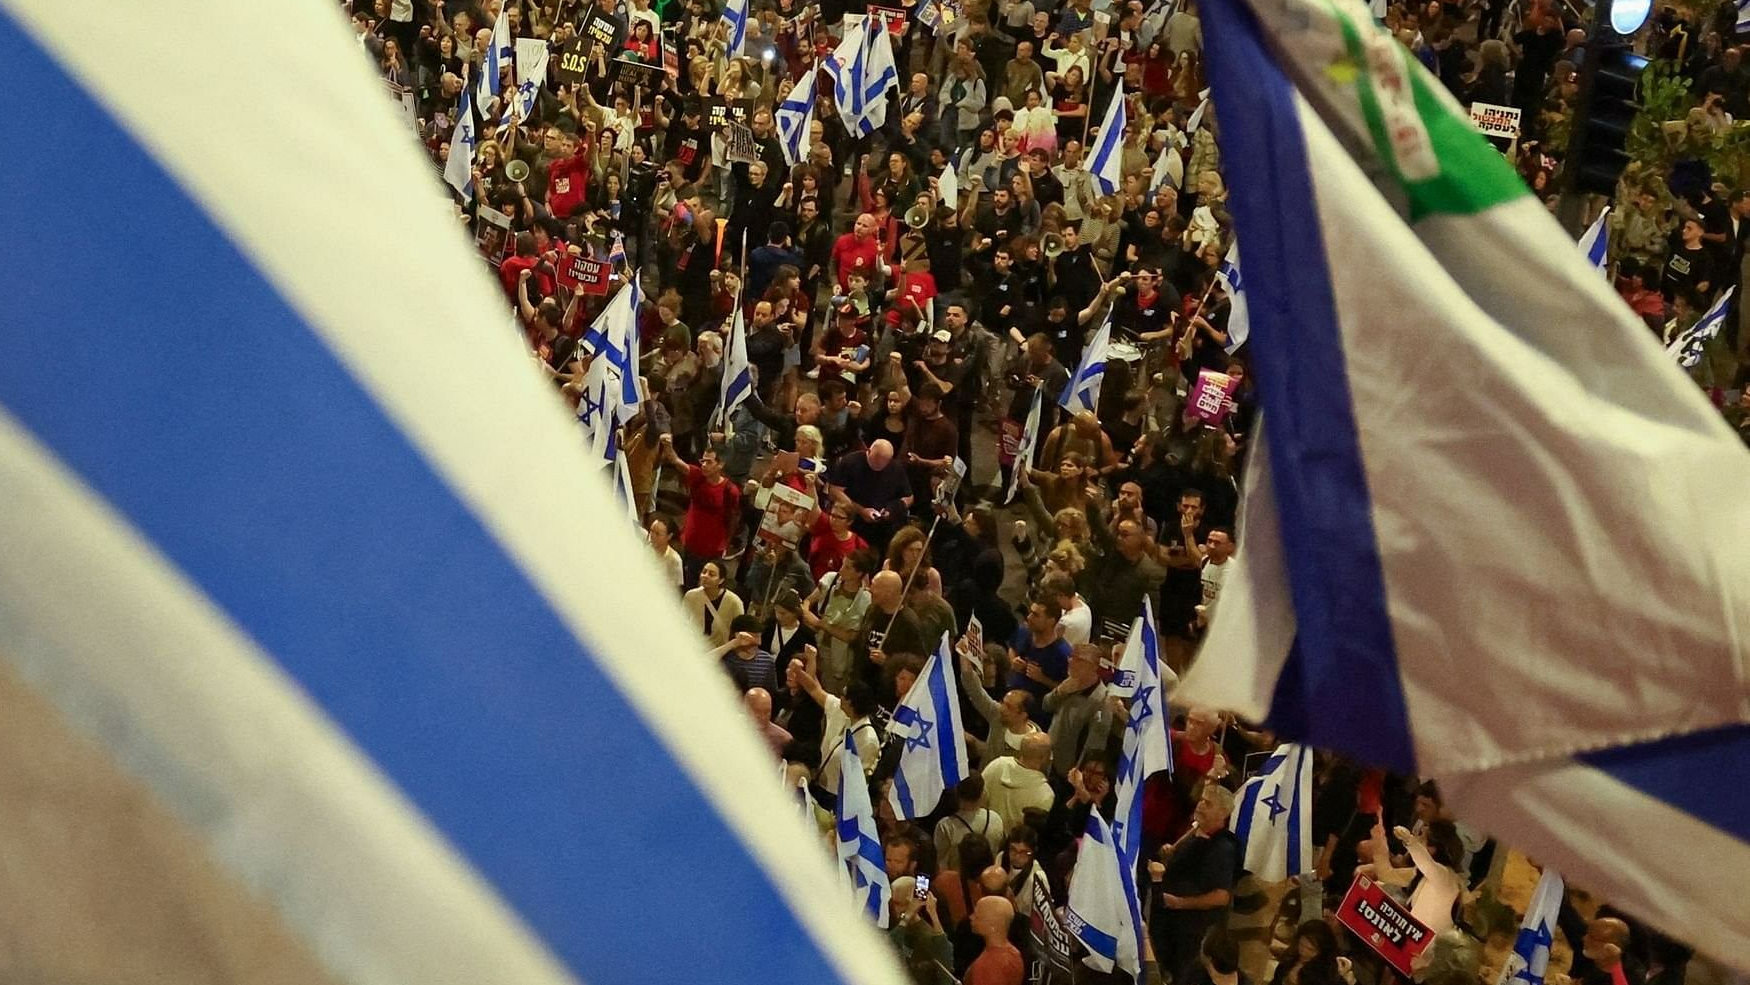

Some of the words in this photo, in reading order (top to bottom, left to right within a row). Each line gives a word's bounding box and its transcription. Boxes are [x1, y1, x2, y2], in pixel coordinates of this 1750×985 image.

[588, 26, 613, 45] עכשיו!
[561, 52, 587, 73] S.O.S
[1473, 112, 1510, 125] המכשול
[1484, 108, 1519, 120] נתניהו
[1479, 122, 1516, 133] לעסקה
[575, 259, 600, 273] עסקה
[569, 269, 598, 283] עכשיו!
[1358, 900, 1402, 943] לאונס!
[1405, 924, 1424, 942] אין
